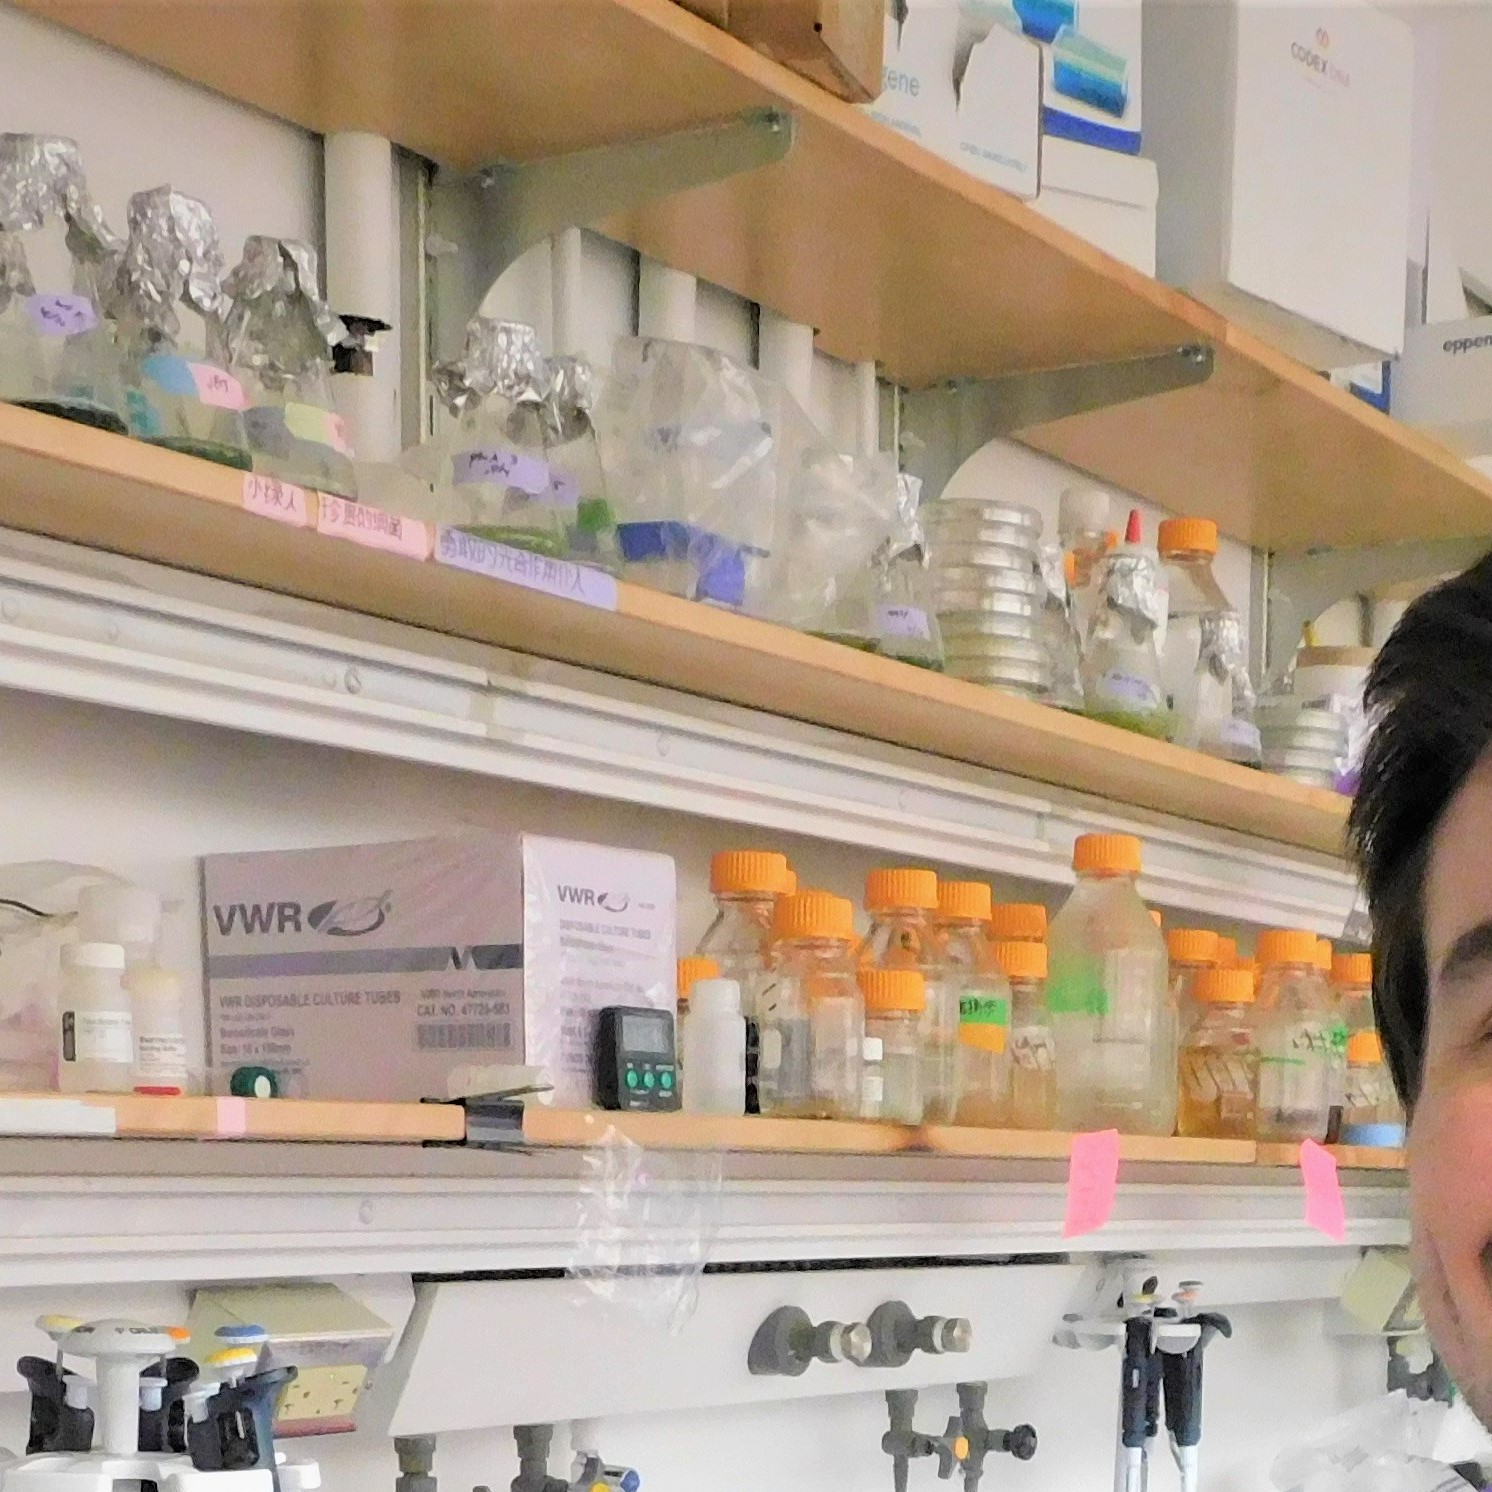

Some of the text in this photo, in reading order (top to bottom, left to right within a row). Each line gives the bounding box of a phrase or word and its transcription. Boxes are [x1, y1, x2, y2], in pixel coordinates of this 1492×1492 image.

[1291, 42, 1328, 74] CODEX
[557, 885, 595, 906] VWR
[213, 901, 302, 936] VWR
[244, 992, 310, 1008] DISPOSABLE
[313, 990, 362, 1006] CULTURE
